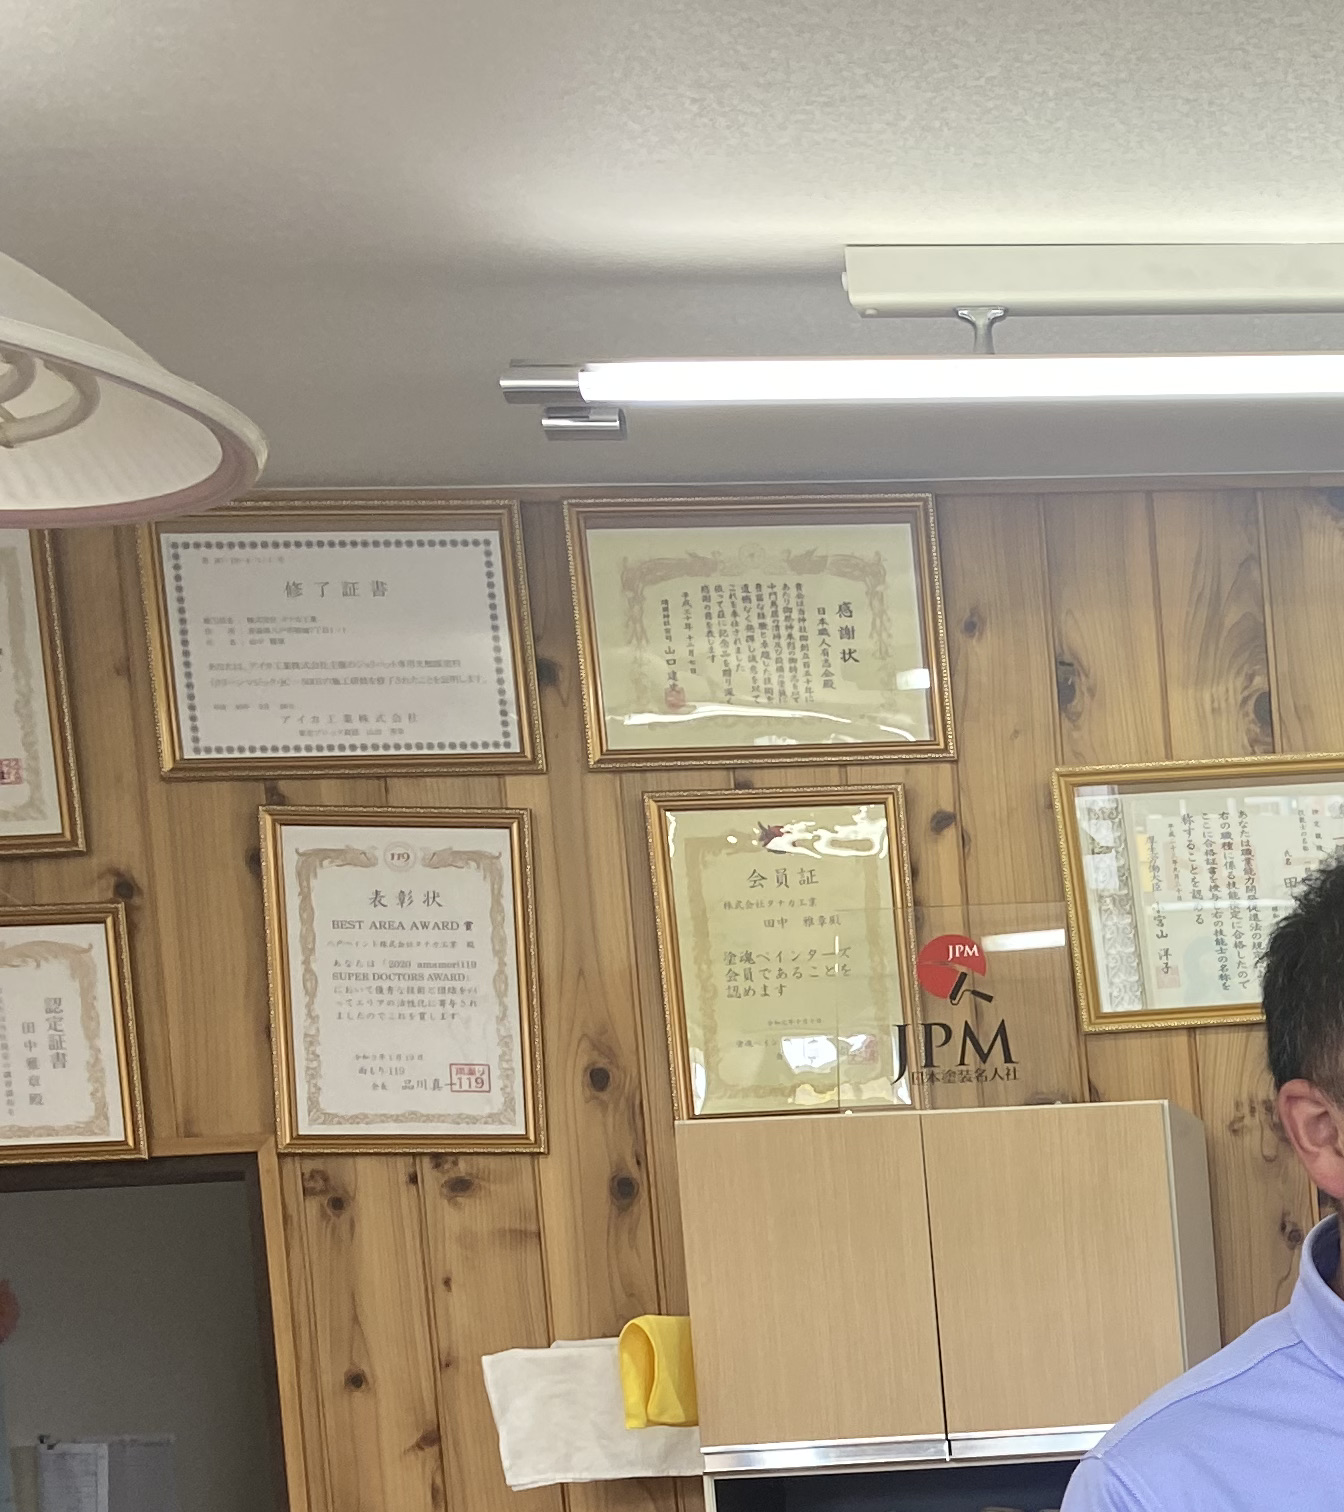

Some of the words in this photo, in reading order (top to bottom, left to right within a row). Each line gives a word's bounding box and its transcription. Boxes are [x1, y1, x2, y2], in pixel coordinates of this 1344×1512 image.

[285, 580, 389, 598] 修了証書
[836, 601, 860, 663] 感謝状
[747, 868, 819, 888] 会員証
[369, 889, 443, 908] 表彰状
[332, 920, 364, 931] BEST
[369, 920, 406, 931] AREA
[410, 920, 460, 931] AWARD
[948, 944, 979, 961] JPM
[372, 972, 425, 982] DOCTORS
[44, 997, 68, 1070] 認定証書
[891, 1019, 1019, 1086] JPM
[911, 1067, 1019, 1086] 日本塗装名人社
